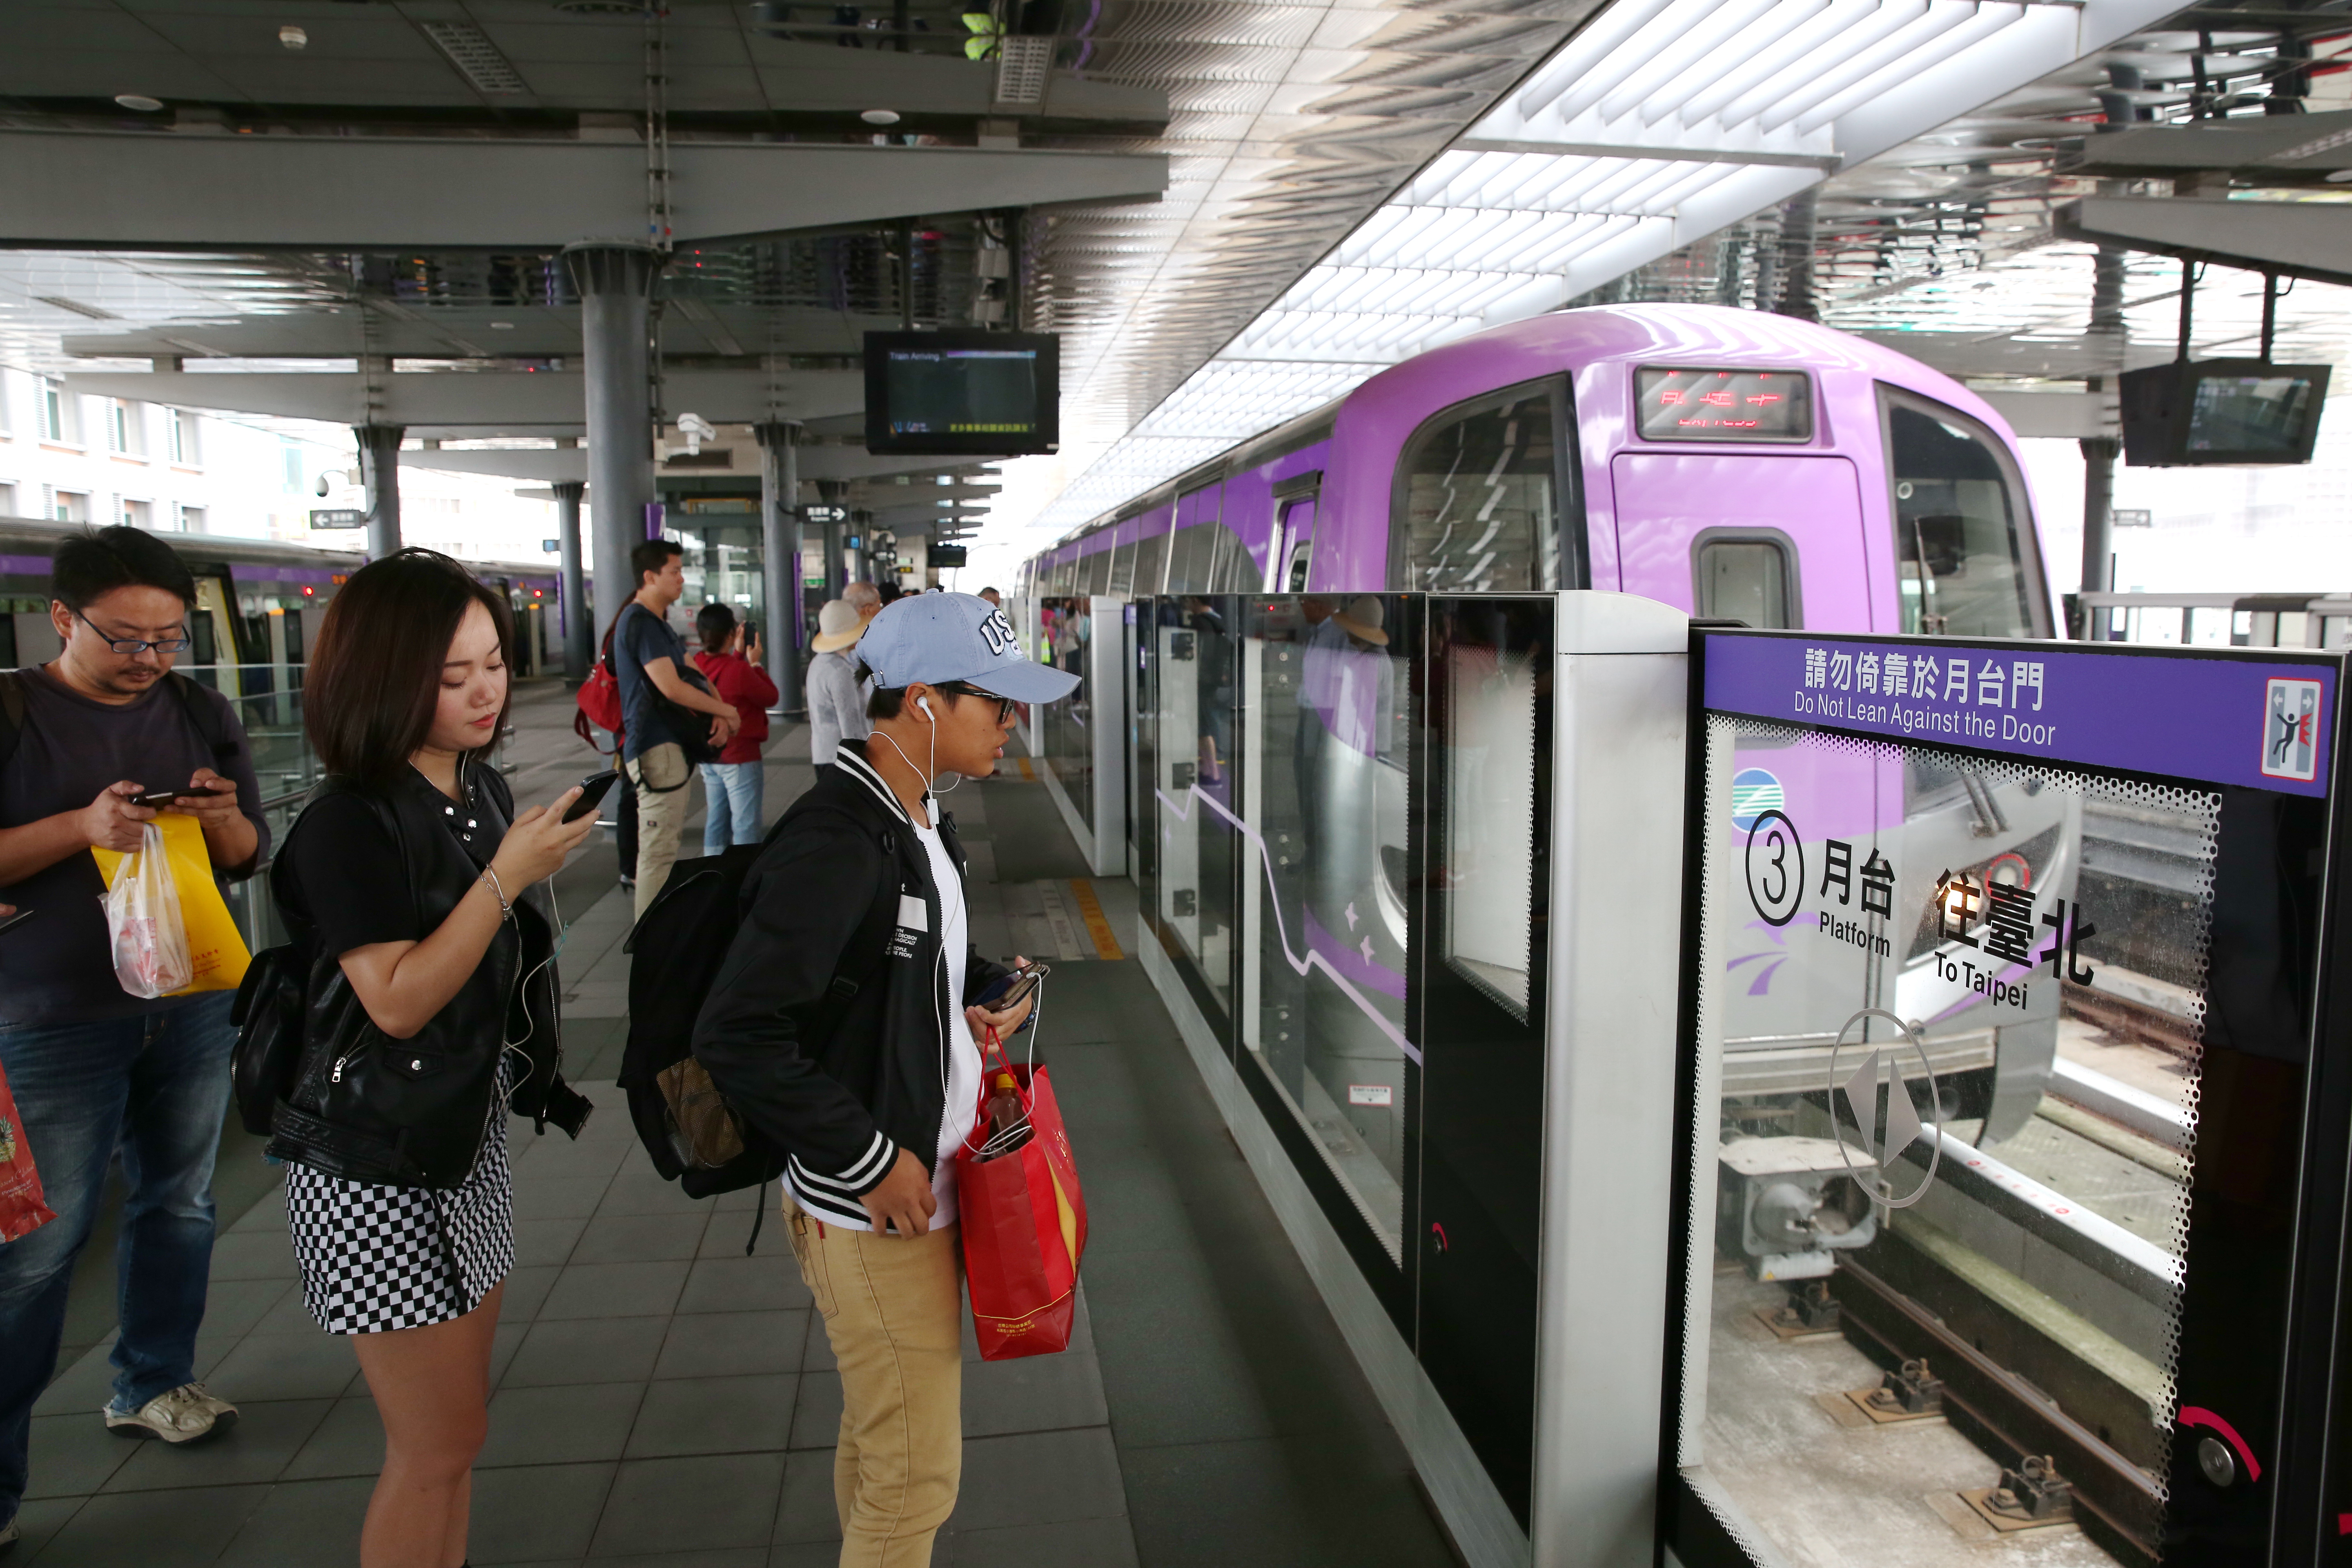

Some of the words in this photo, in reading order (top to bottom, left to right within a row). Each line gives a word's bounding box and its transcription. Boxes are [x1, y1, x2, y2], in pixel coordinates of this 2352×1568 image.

[979, 609, 1016, 656] US
[1805, 648, 2044, 711] 請勿倚靠於月台門
[1795, 690, 1814, 714] Do
[1818, 693, 1843, 718] Not
[1848, 697, 1886, 724] Lean
[1891, 702, 1959, 733] Against
[1964, 711, 1996, 738] the
[2002, 714, 2056, 746] Door
[1820, 838, 1895, 921] 月台
[1820, 911, 1890, 958] Platform
[1935, 868, 2096, 987] 往臺北
[1934, 951, 1957, 982] To
[1962, 961, 2027, 1010] Taipei
[2, 1183, 26, 1196] Pineapple
